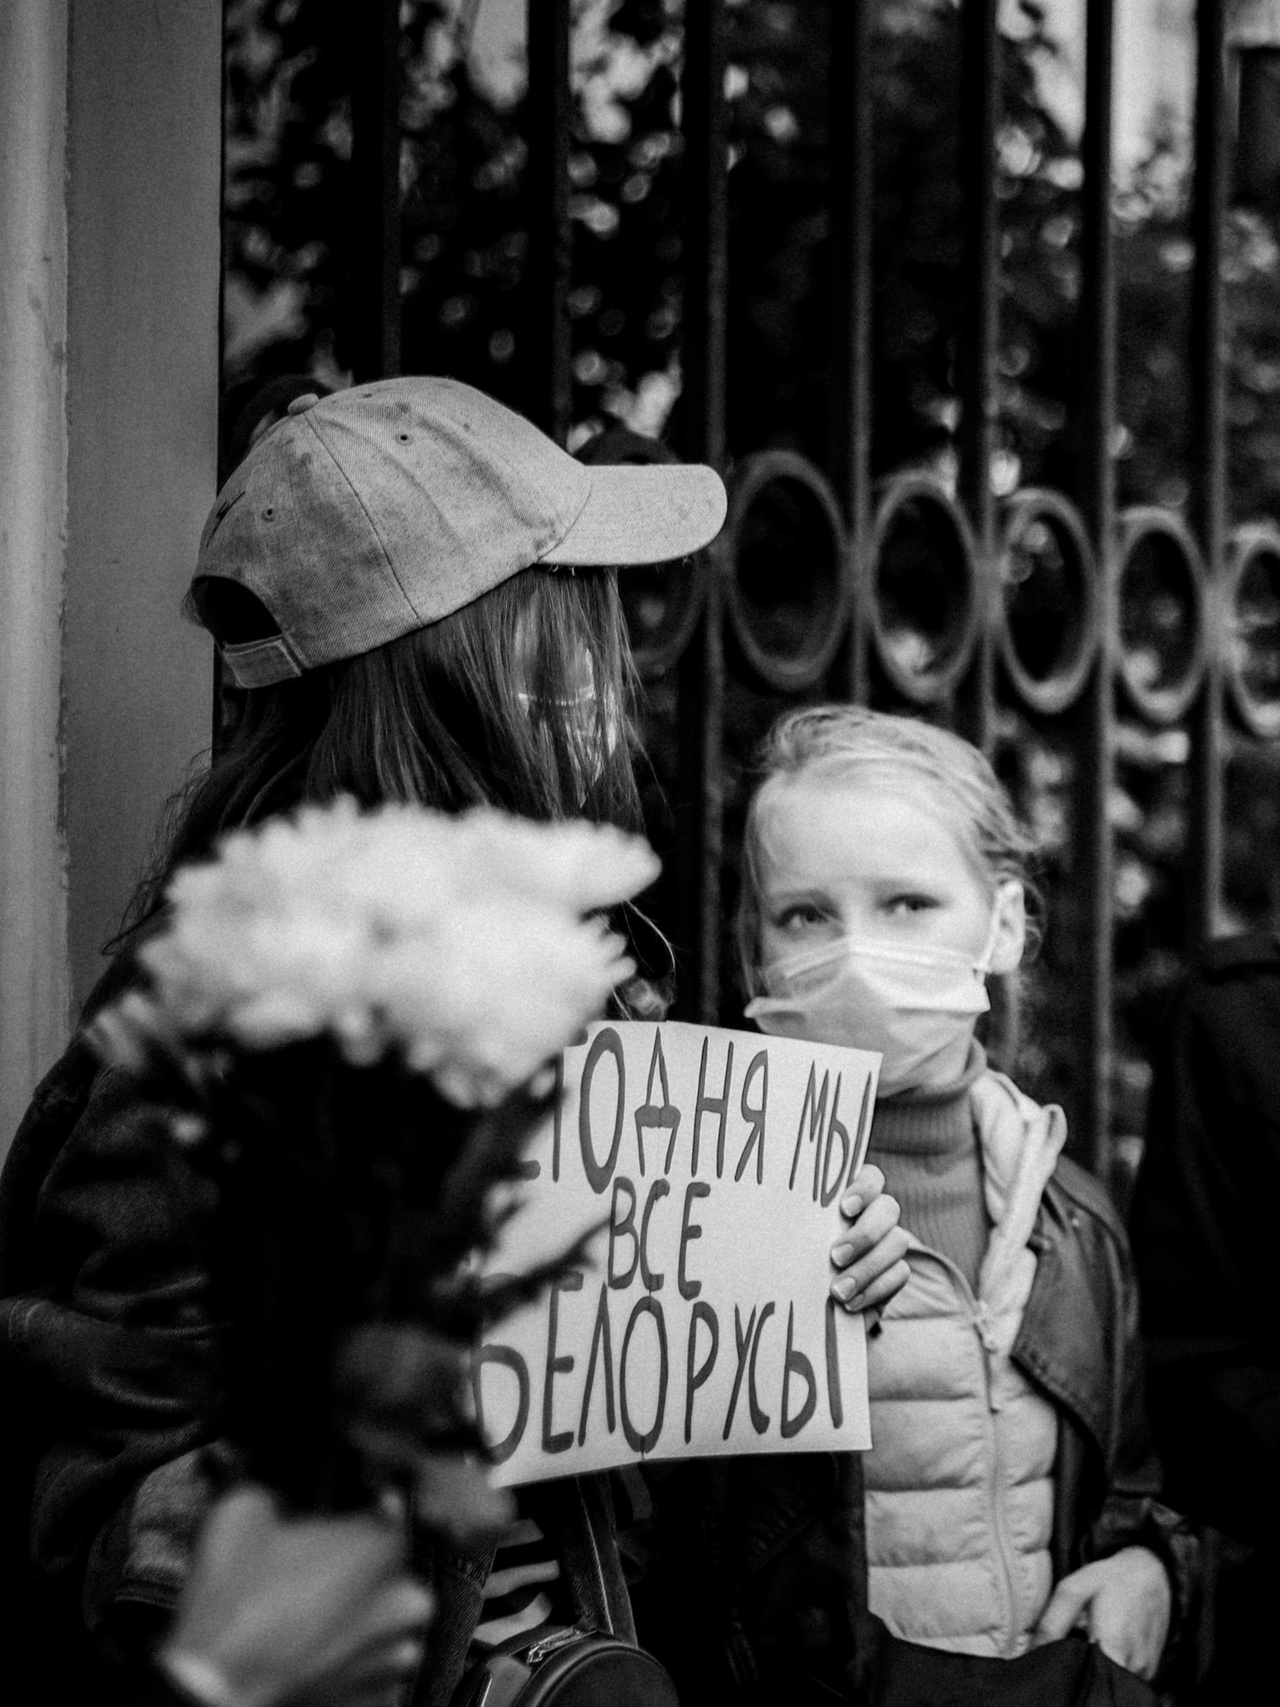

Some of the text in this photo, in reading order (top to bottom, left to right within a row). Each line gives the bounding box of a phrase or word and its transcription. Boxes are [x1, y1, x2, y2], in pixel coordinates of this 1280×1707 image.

[521, 1026, 872, 1208] ГОДНЯ МЫ
[607, 1176, 711, 1301] ВСЕ
[473, 1269, 844, 1467] БЕЛОРУСЫ
